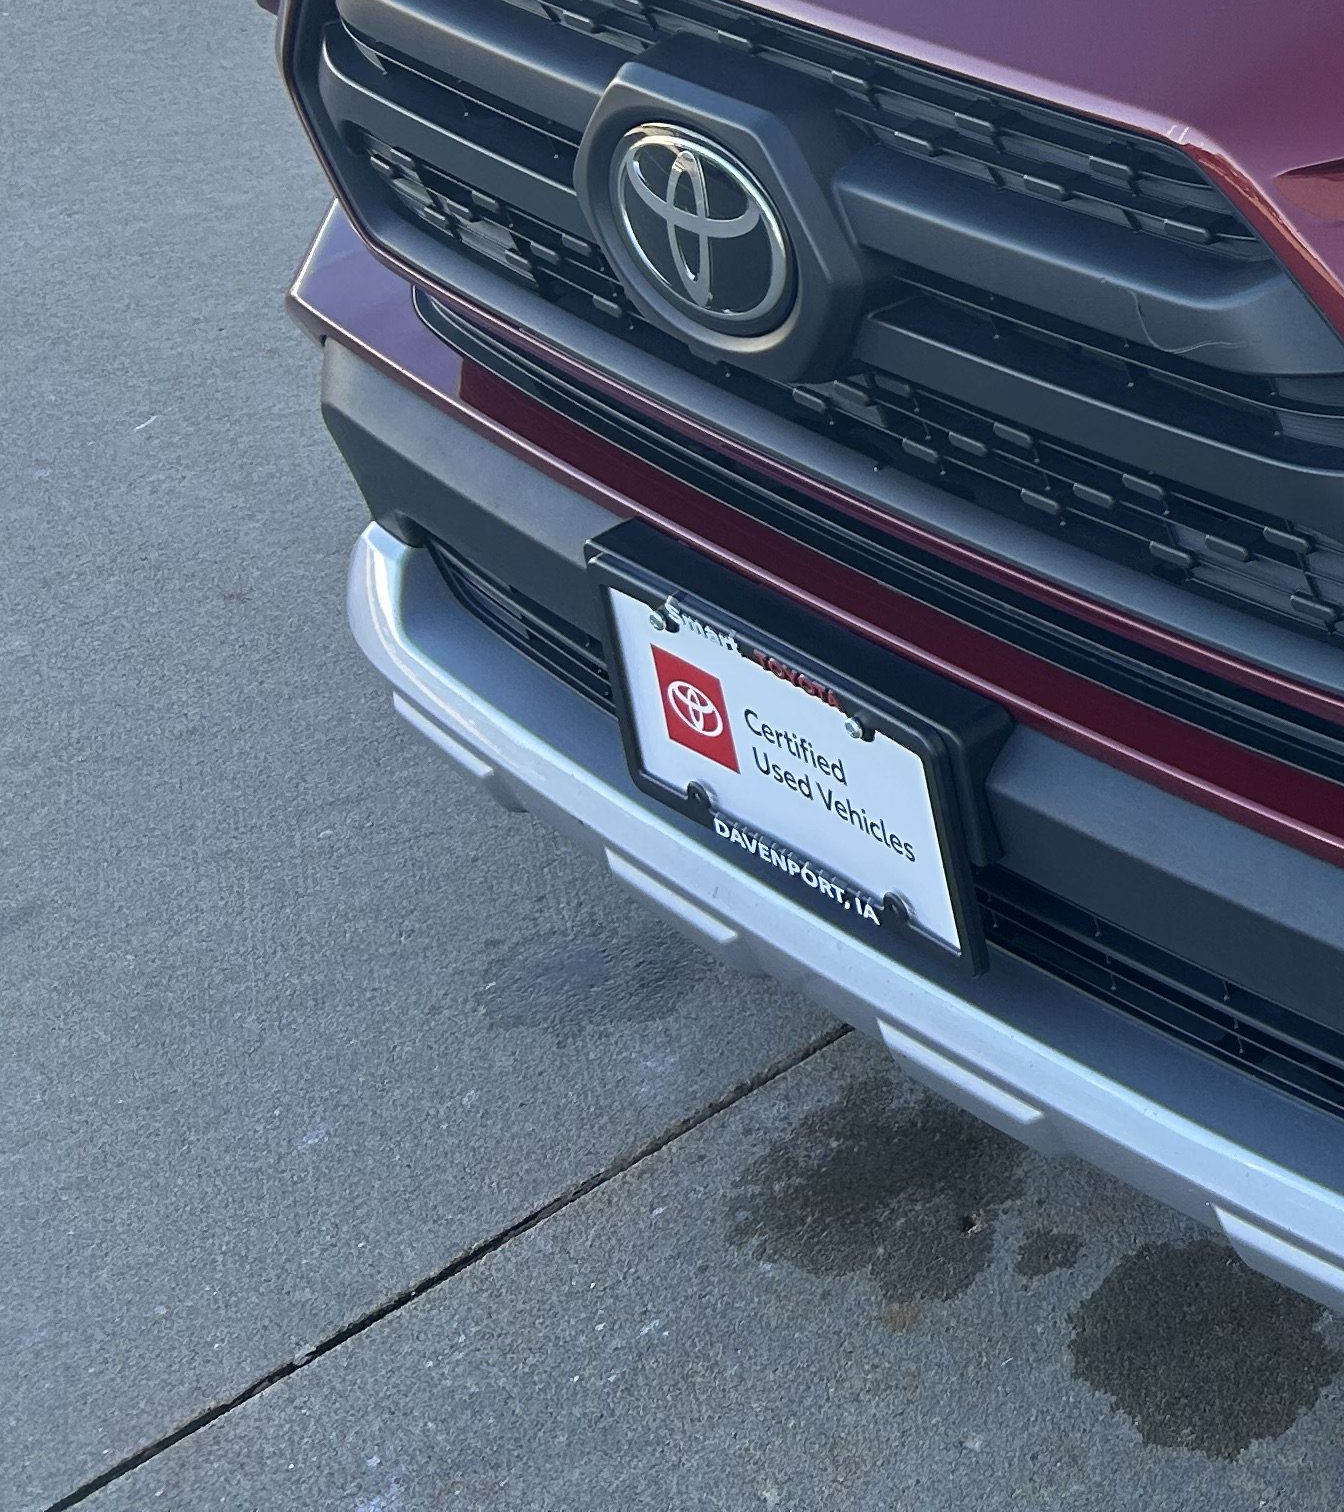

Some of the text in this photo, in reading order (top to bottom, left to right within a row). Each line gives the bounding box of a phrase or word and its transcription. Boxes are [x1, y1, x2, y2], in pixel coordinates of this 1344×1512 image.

[665, 595, 841, 708] Smart TOYOTA
[744, 708, 848, 787] Certified
[752, 746, 916, 863] Used Vehicles
[854, 896, 881, 926] IA
